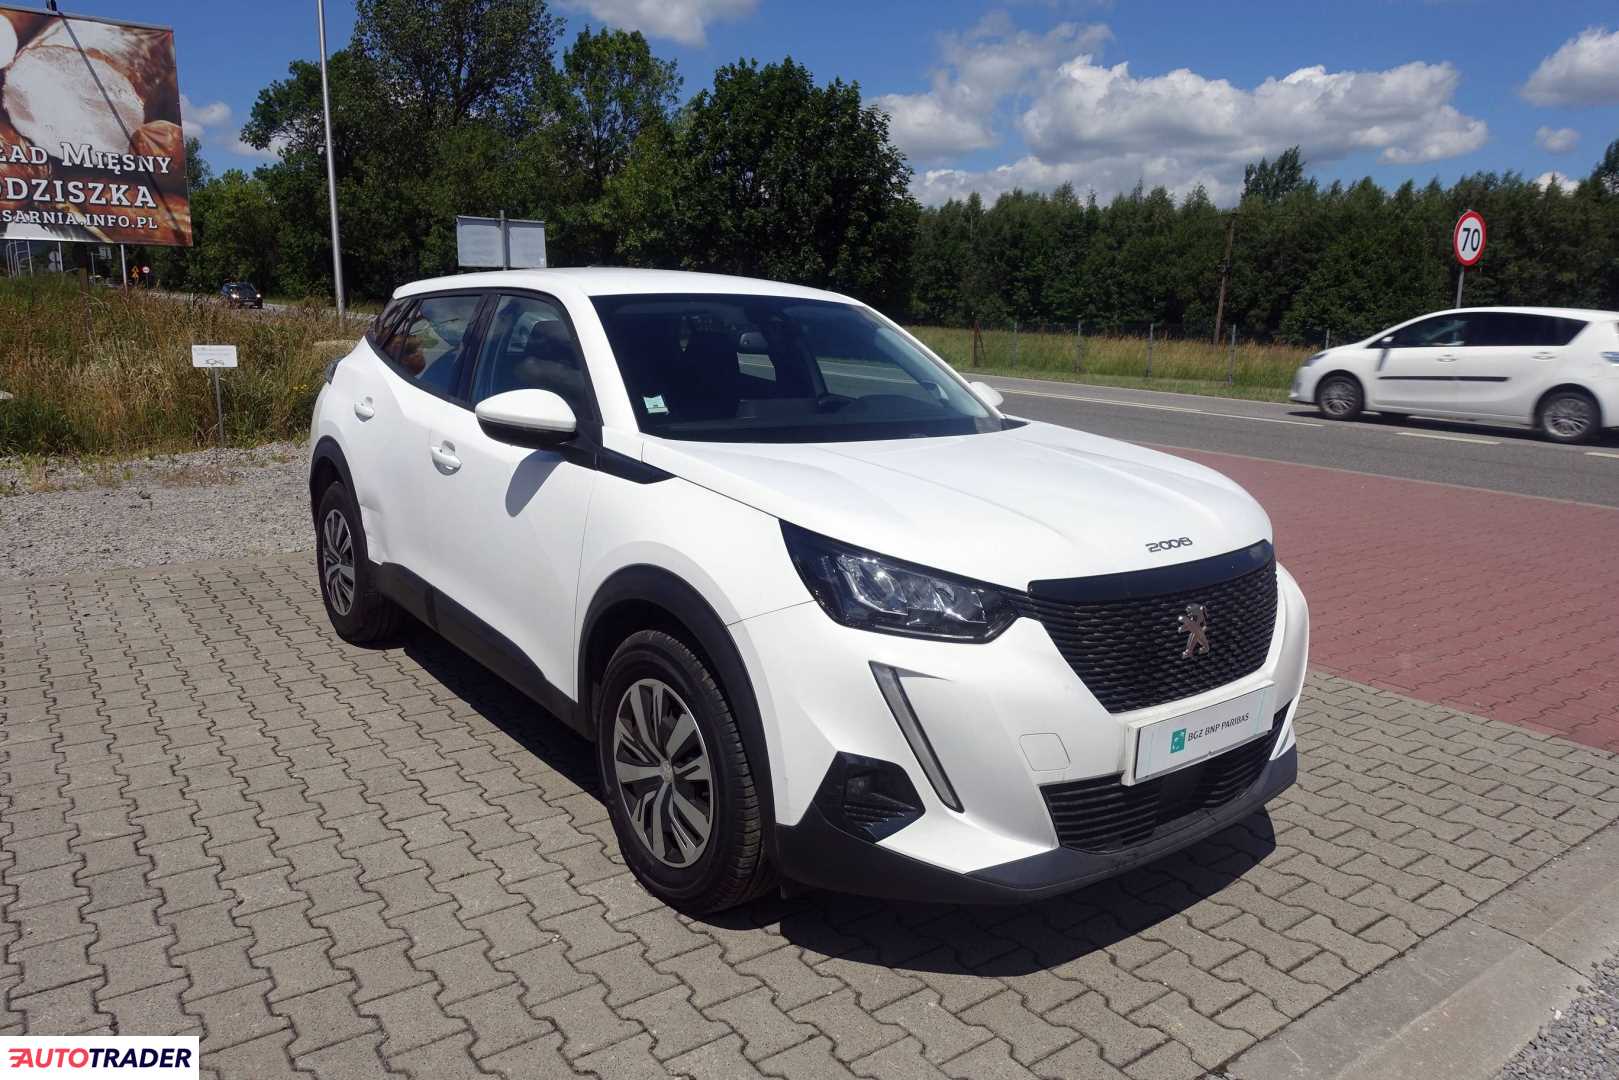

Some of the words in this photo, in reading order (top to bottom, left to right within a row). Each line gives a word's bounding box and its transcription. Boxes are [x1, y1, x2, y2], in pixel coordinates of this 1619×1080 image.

[61, 142, 171, 174] MIĘSNY
[0, 177, 157, 208] DZISZKA
[2, 209, 158, 229] SARNIA.INFO.PL
[1462, 227, 1480, 252] 70
[1145, 536, 1193, 552] 2008
[1204, 722, 1221, 736] BNP
[1221, 712, 1249, 730] PARIBAS
